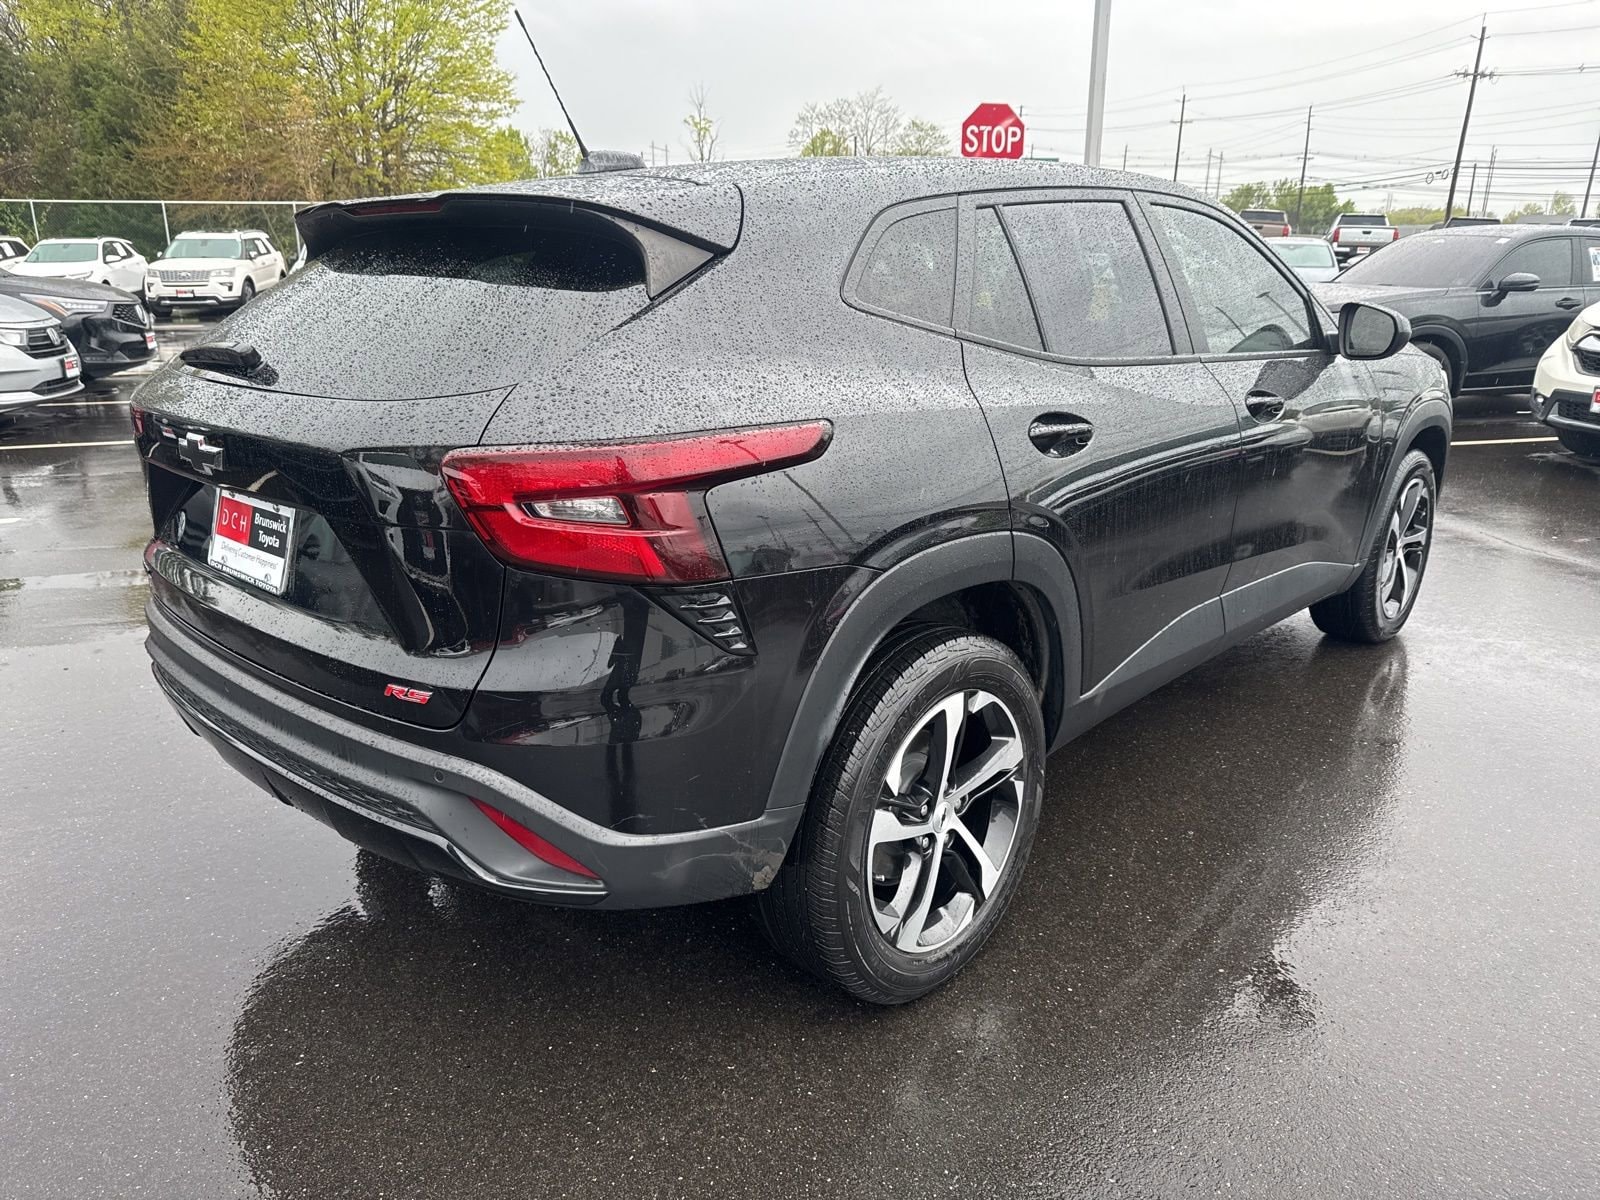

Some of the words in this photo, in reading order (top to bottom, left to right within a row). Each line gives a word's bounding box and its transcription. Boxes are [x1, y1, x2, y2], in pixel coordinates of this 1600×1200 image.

[965, 124, 1021, 153] STOP
[222, 509, 247, 532] DCH
[254, 513, 287, 533] Brunswick
[258, 530, 280, 548] Toyota
[210, 560, 222, 570] DCH
[222, 566, 256, 585] BRUNSWICK
[255, 579, 277, 593] TOYOTA
[384, 684, 433, 704] RS
